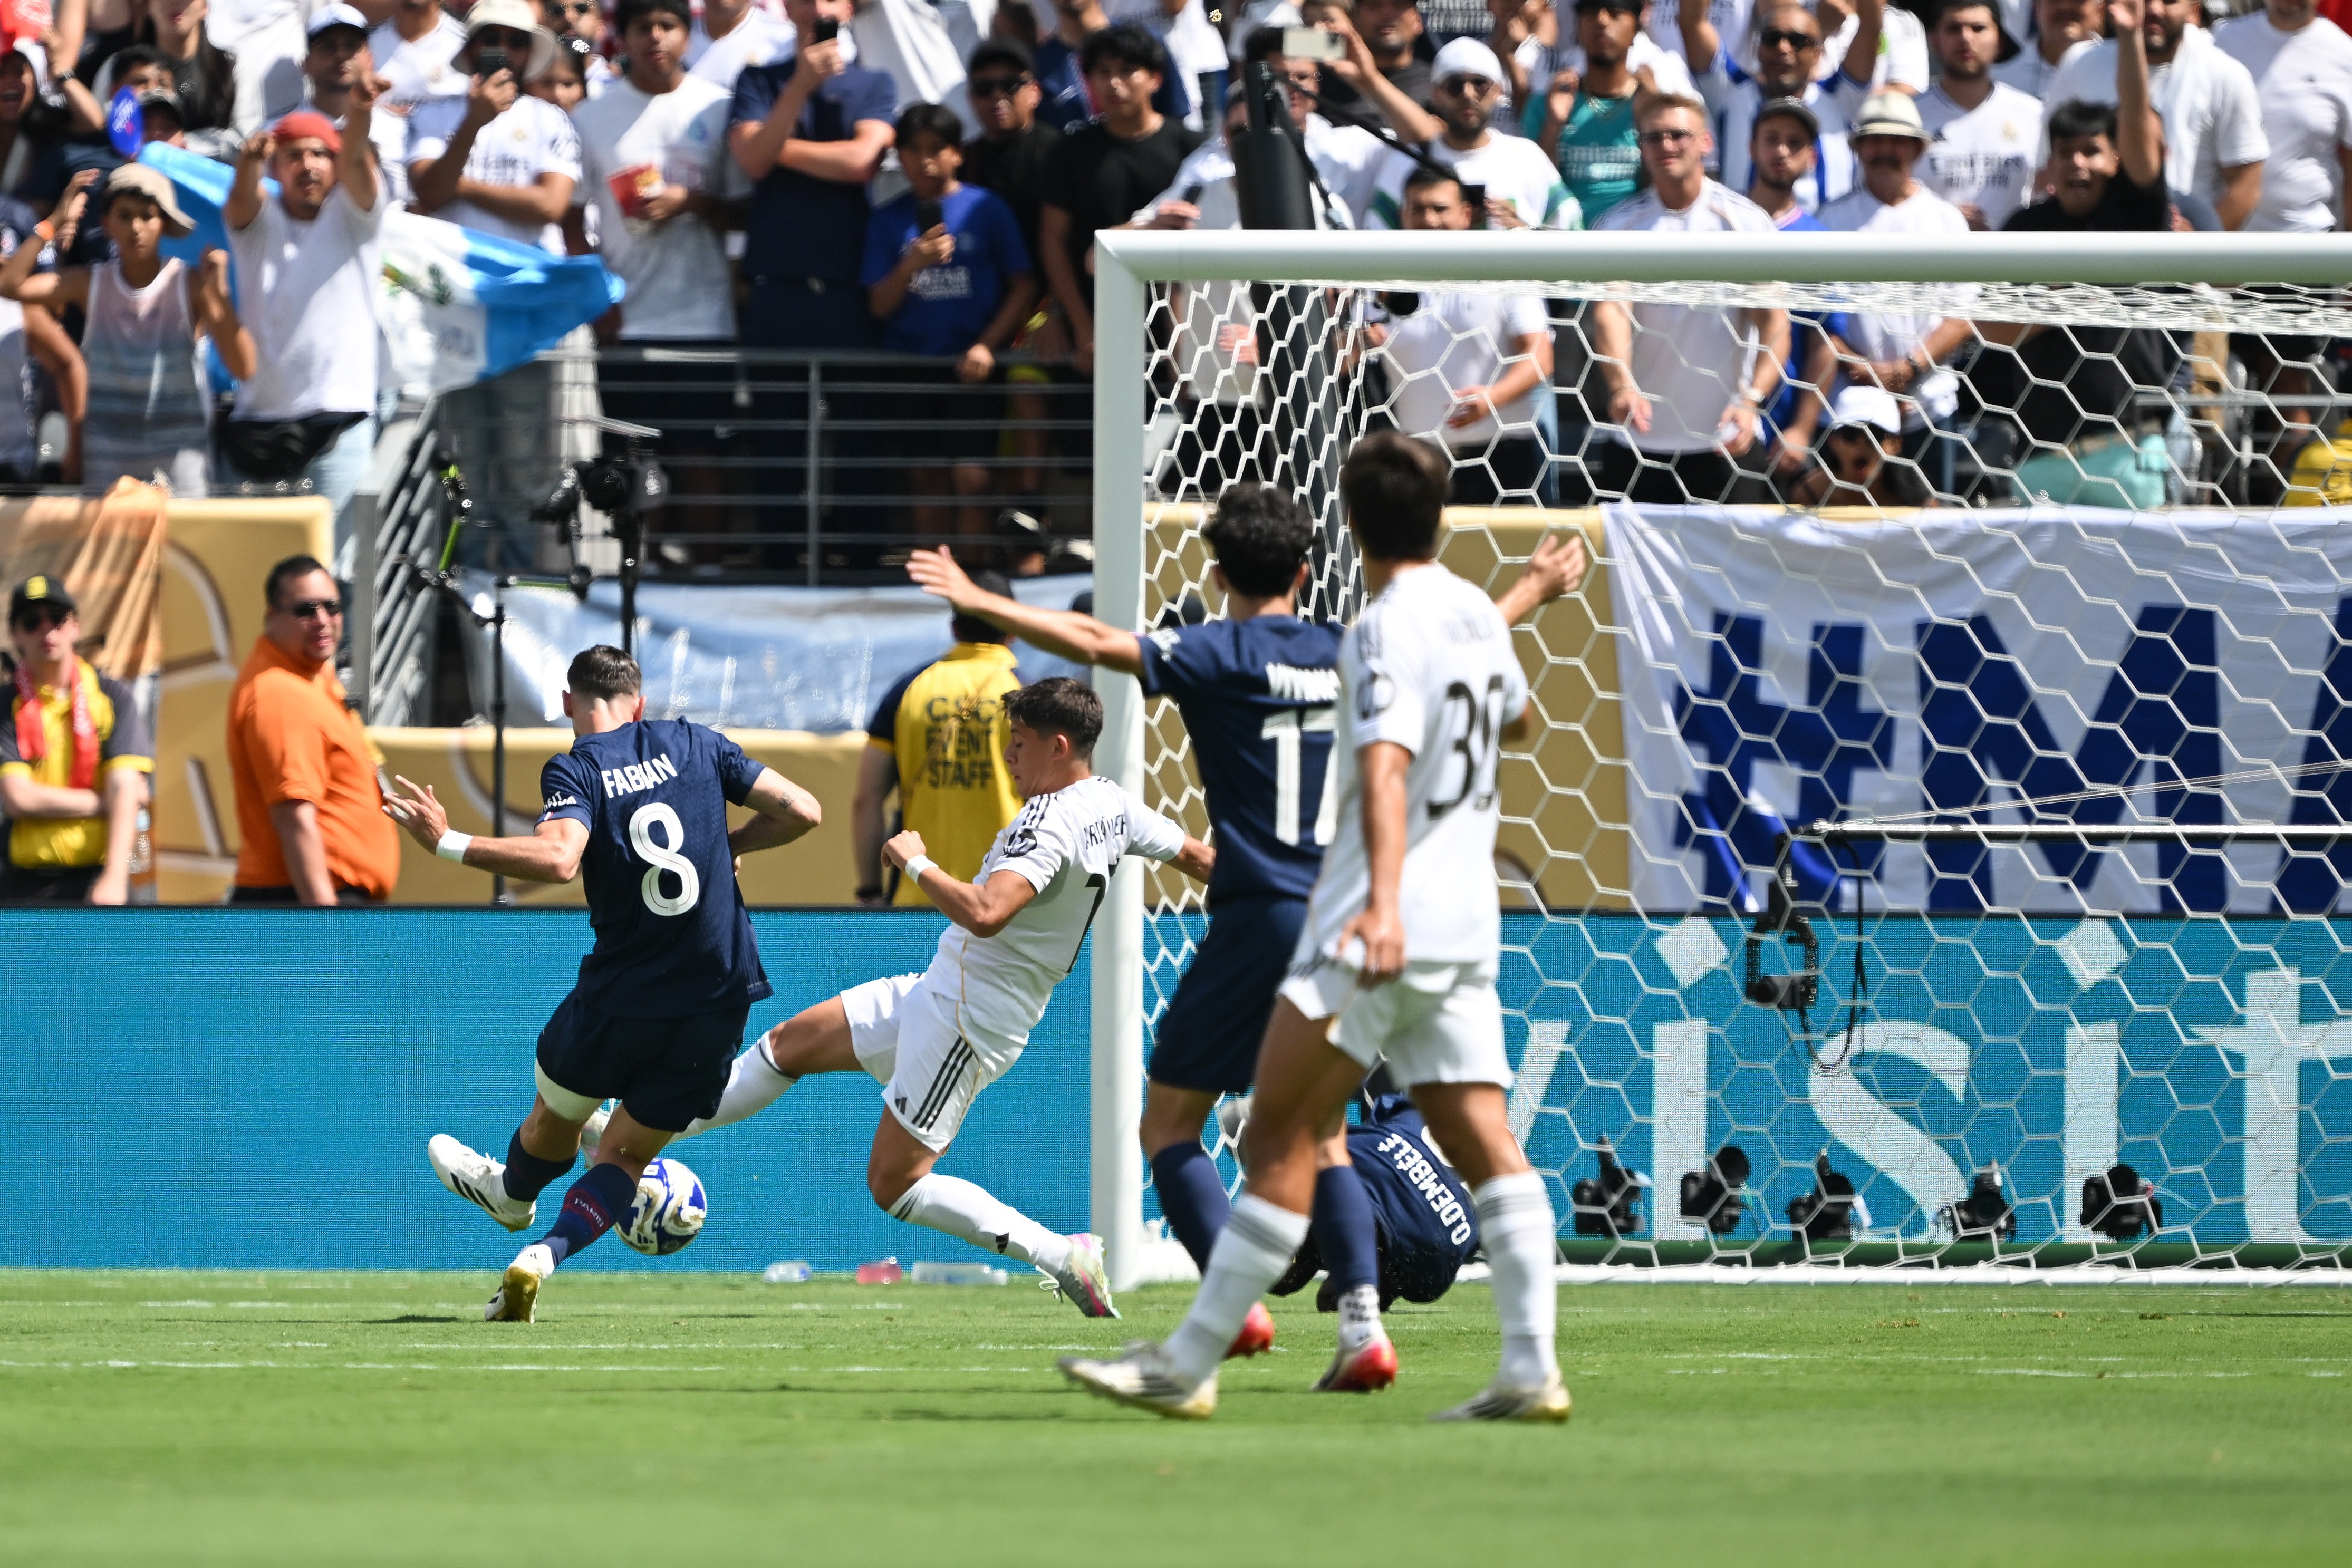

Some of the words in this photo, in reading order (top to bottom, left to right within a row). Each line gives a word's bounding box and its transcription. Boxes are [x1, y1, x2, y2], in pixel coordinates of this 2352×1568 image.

[926, 726, 993, 756] EVENT
[601, 753, 678, 799] FABIAN
[929, 760, 993, 788] STAFF
[1260, 710, 1339, 846] 17
[629, 802, 700, 917] 8
[1066, 860, 1119, 973] 7
[574, 1198, 604, 1227] PARIS
